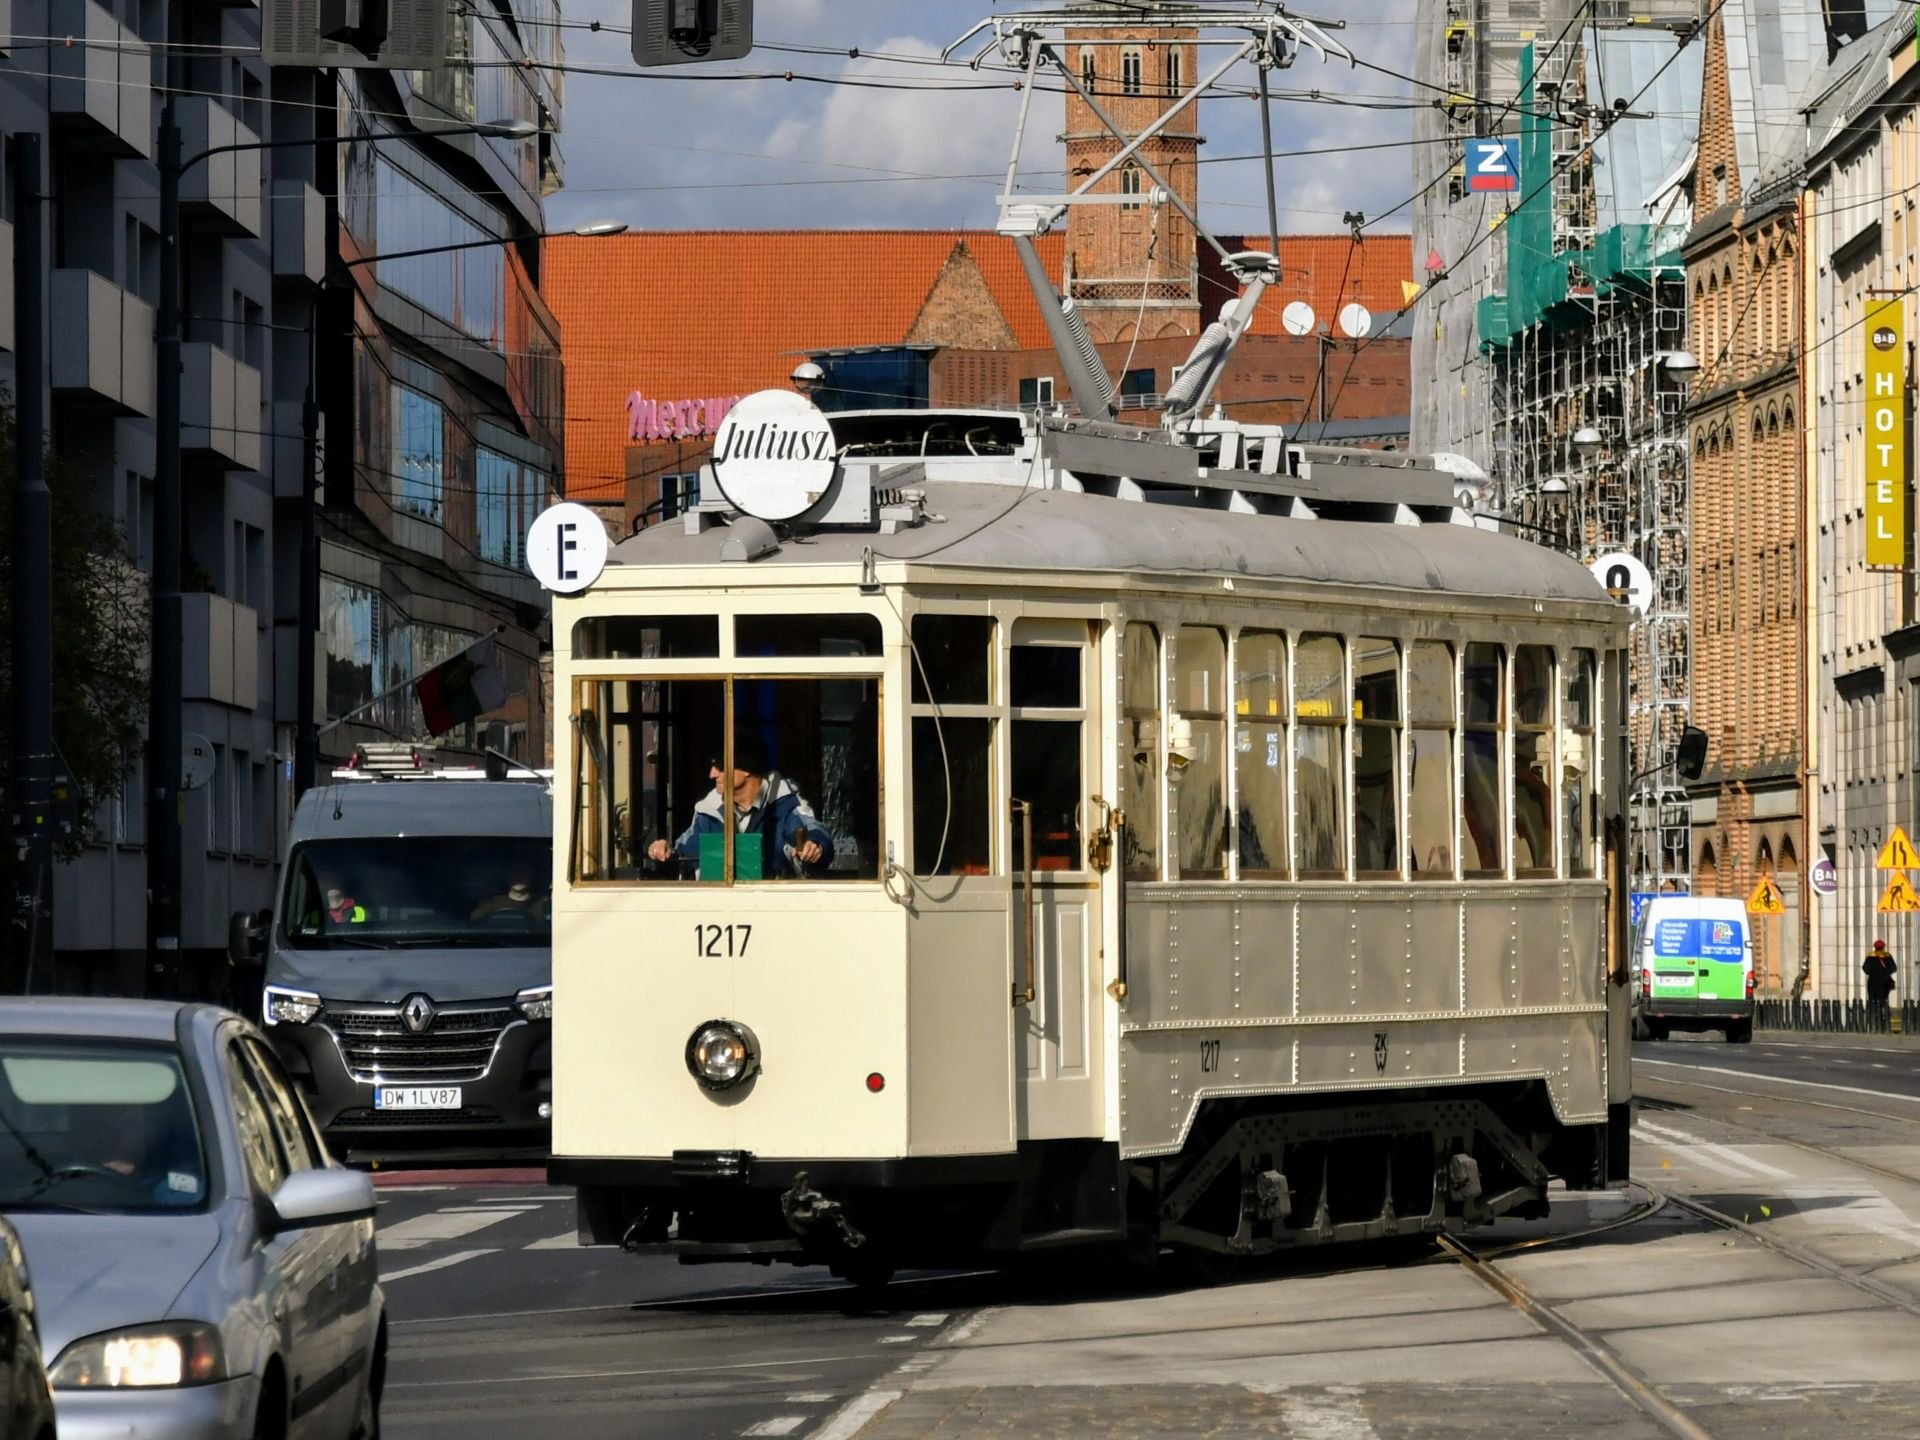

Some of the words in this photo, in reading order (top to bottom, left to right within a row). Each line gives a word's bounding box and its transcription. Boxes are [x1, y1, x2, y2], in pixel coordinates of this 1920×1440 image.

[720, 422, 830, 465] Juliusz
[1875, 372, 1894, 539] HOTEL
[557, 523, 578, 581] E
[695, 924, 752, 957] 1217
[1200, 1040, 1220, 1072] 1217
[385, 1091, 404, 1105] DW
[412, 1089, 457, 1104] 1LV87
